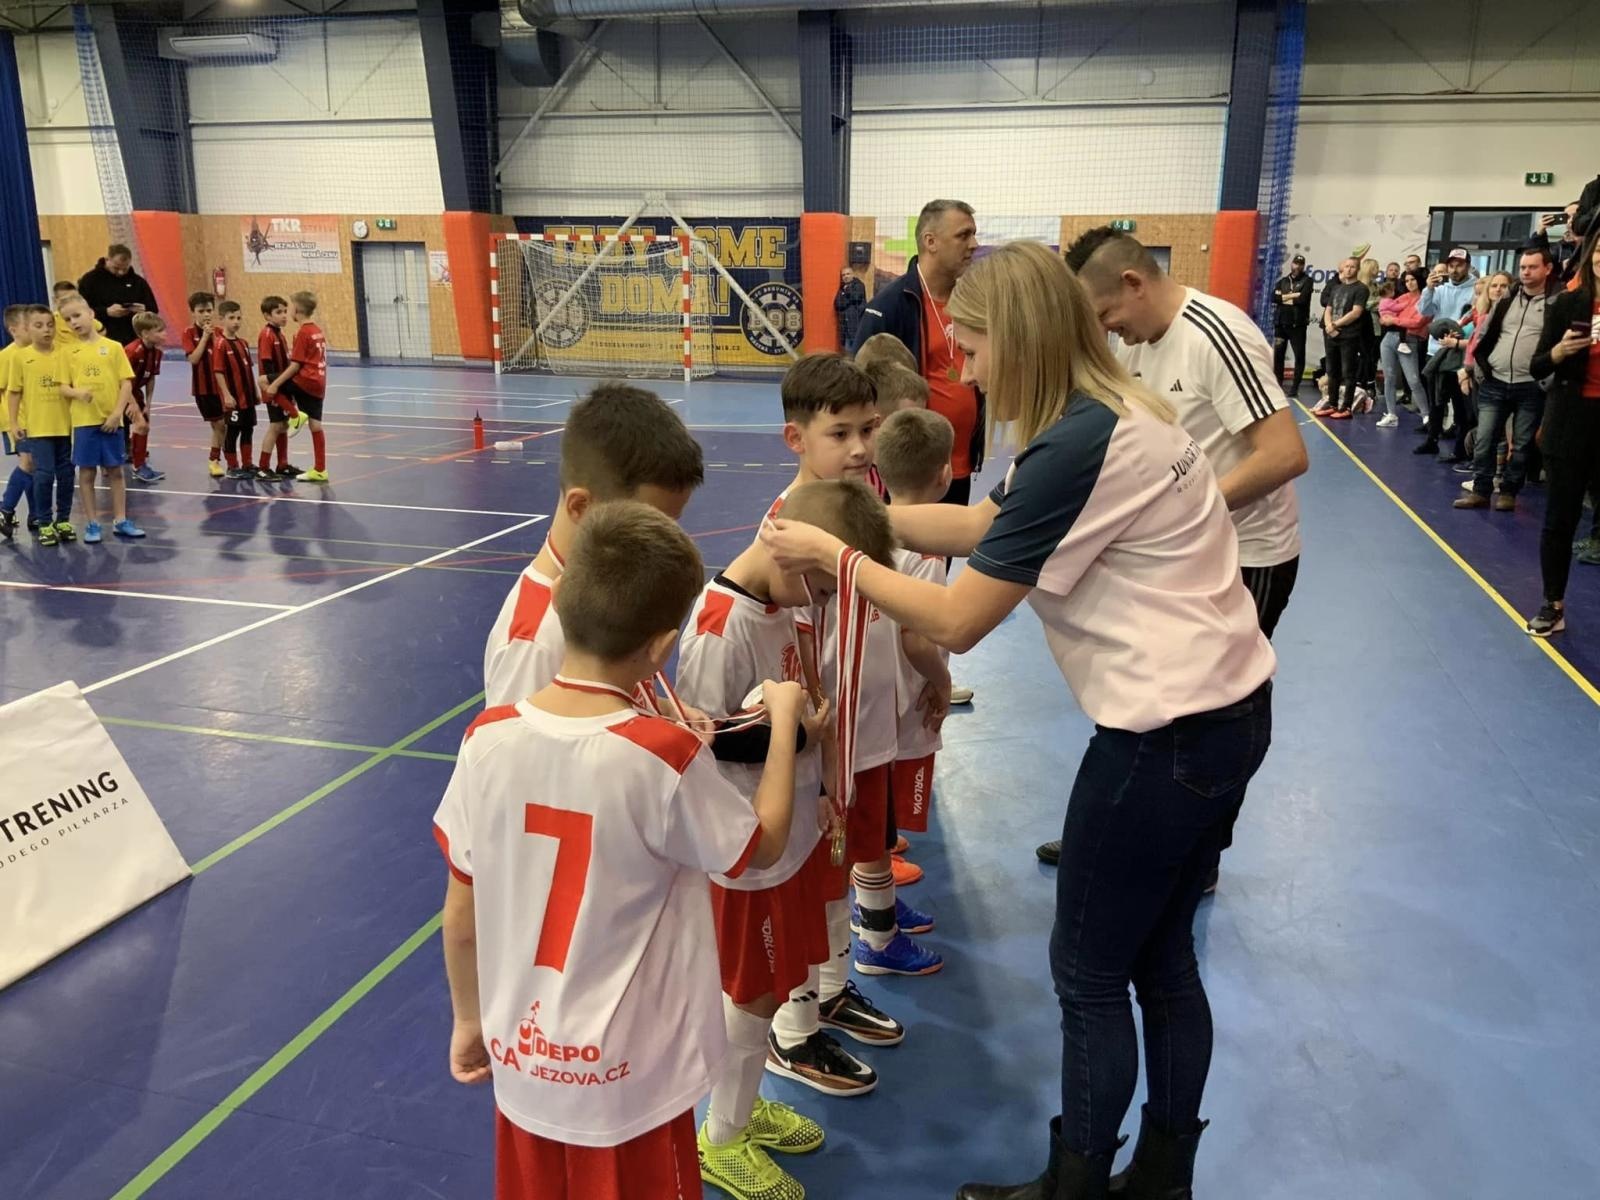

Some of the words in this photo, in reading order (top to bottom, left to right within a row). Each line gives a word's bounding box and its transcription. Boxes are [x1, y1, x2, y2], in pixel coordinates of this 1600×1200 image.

[271, 218, 301, 232] TKR
[0, 771, 119, 843] TRENING
[525, 803, 594, 974] 7
[536, 1036, 601, 1062] DEPO
